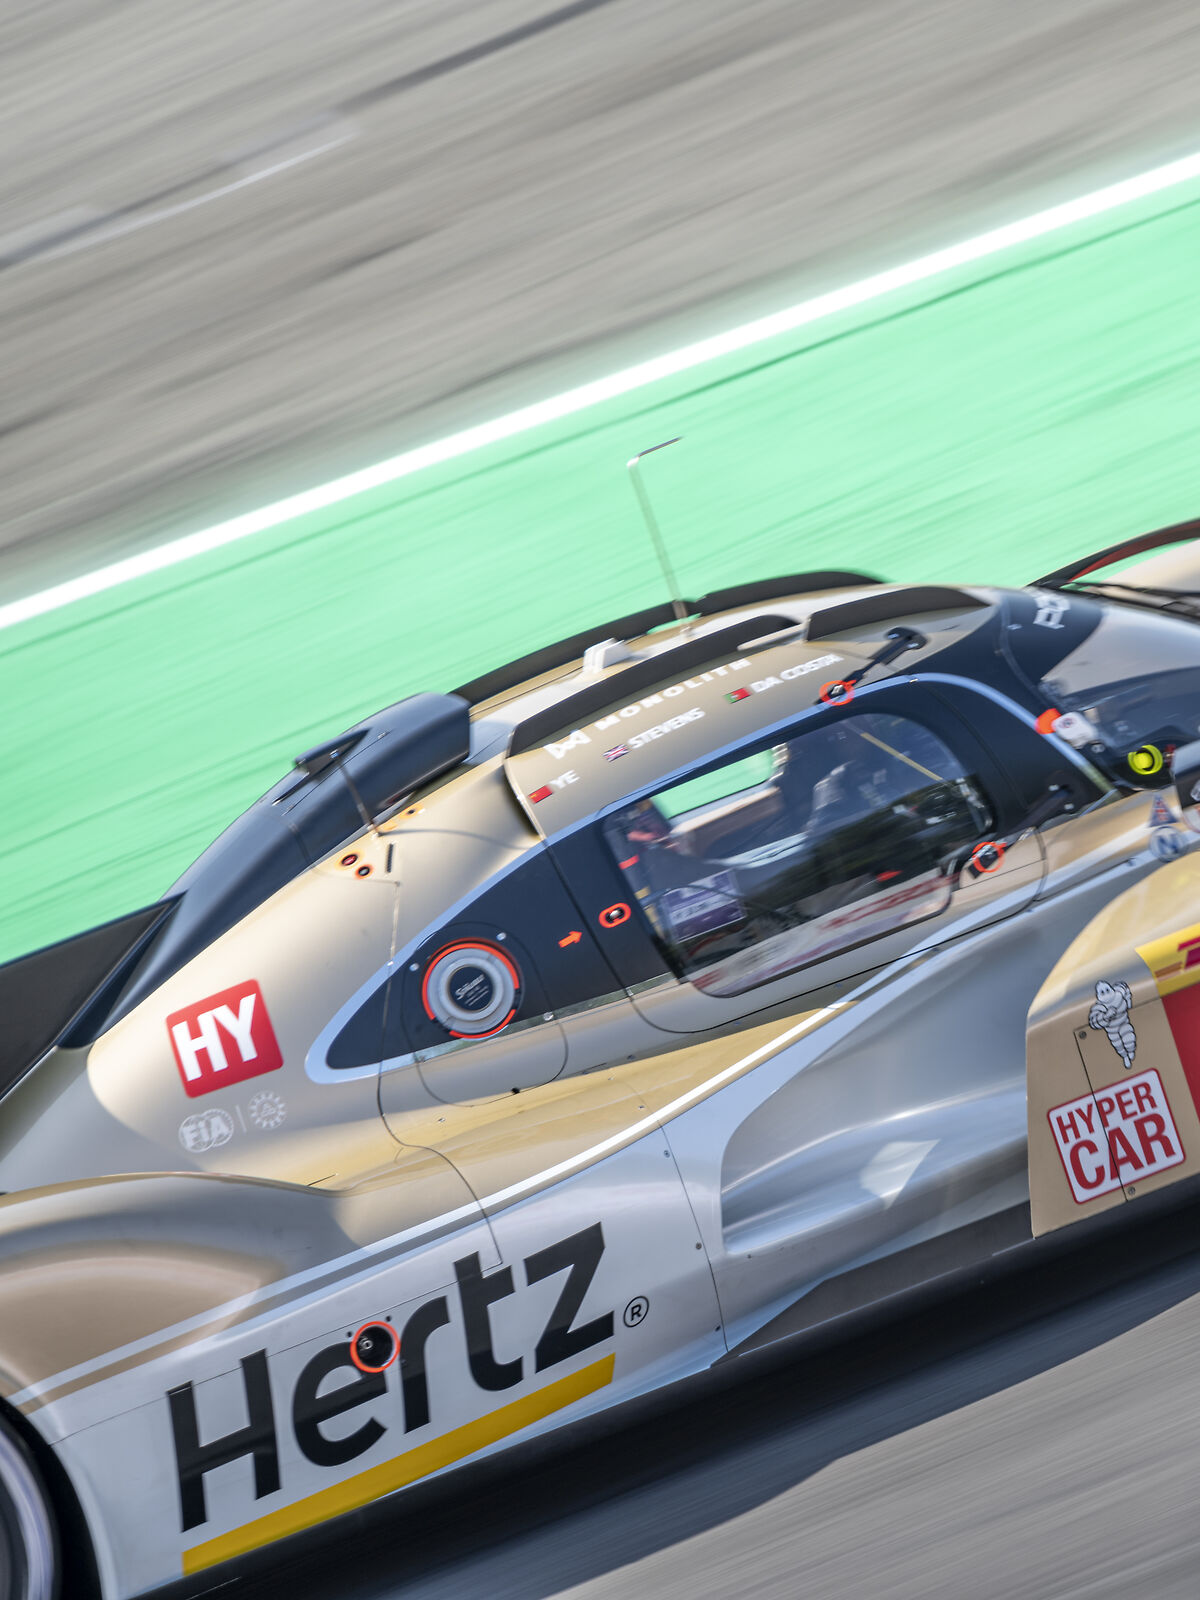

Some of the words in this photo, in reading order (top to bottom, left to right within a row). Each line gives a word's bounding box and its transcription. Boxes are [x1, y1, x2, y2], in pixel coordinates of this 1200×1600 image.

[749, 676, 784, 693] DA
[627, 707, 706, 749] STEVENS
[549, 769, 580, 790] YE
[171, 993, 258, 1082] HY
[1055, 1081, 1158, 1144] HYPER
[1069, 1112, 1177, 1190] CAR
[167, 1221, 615, 1533] Hertz
